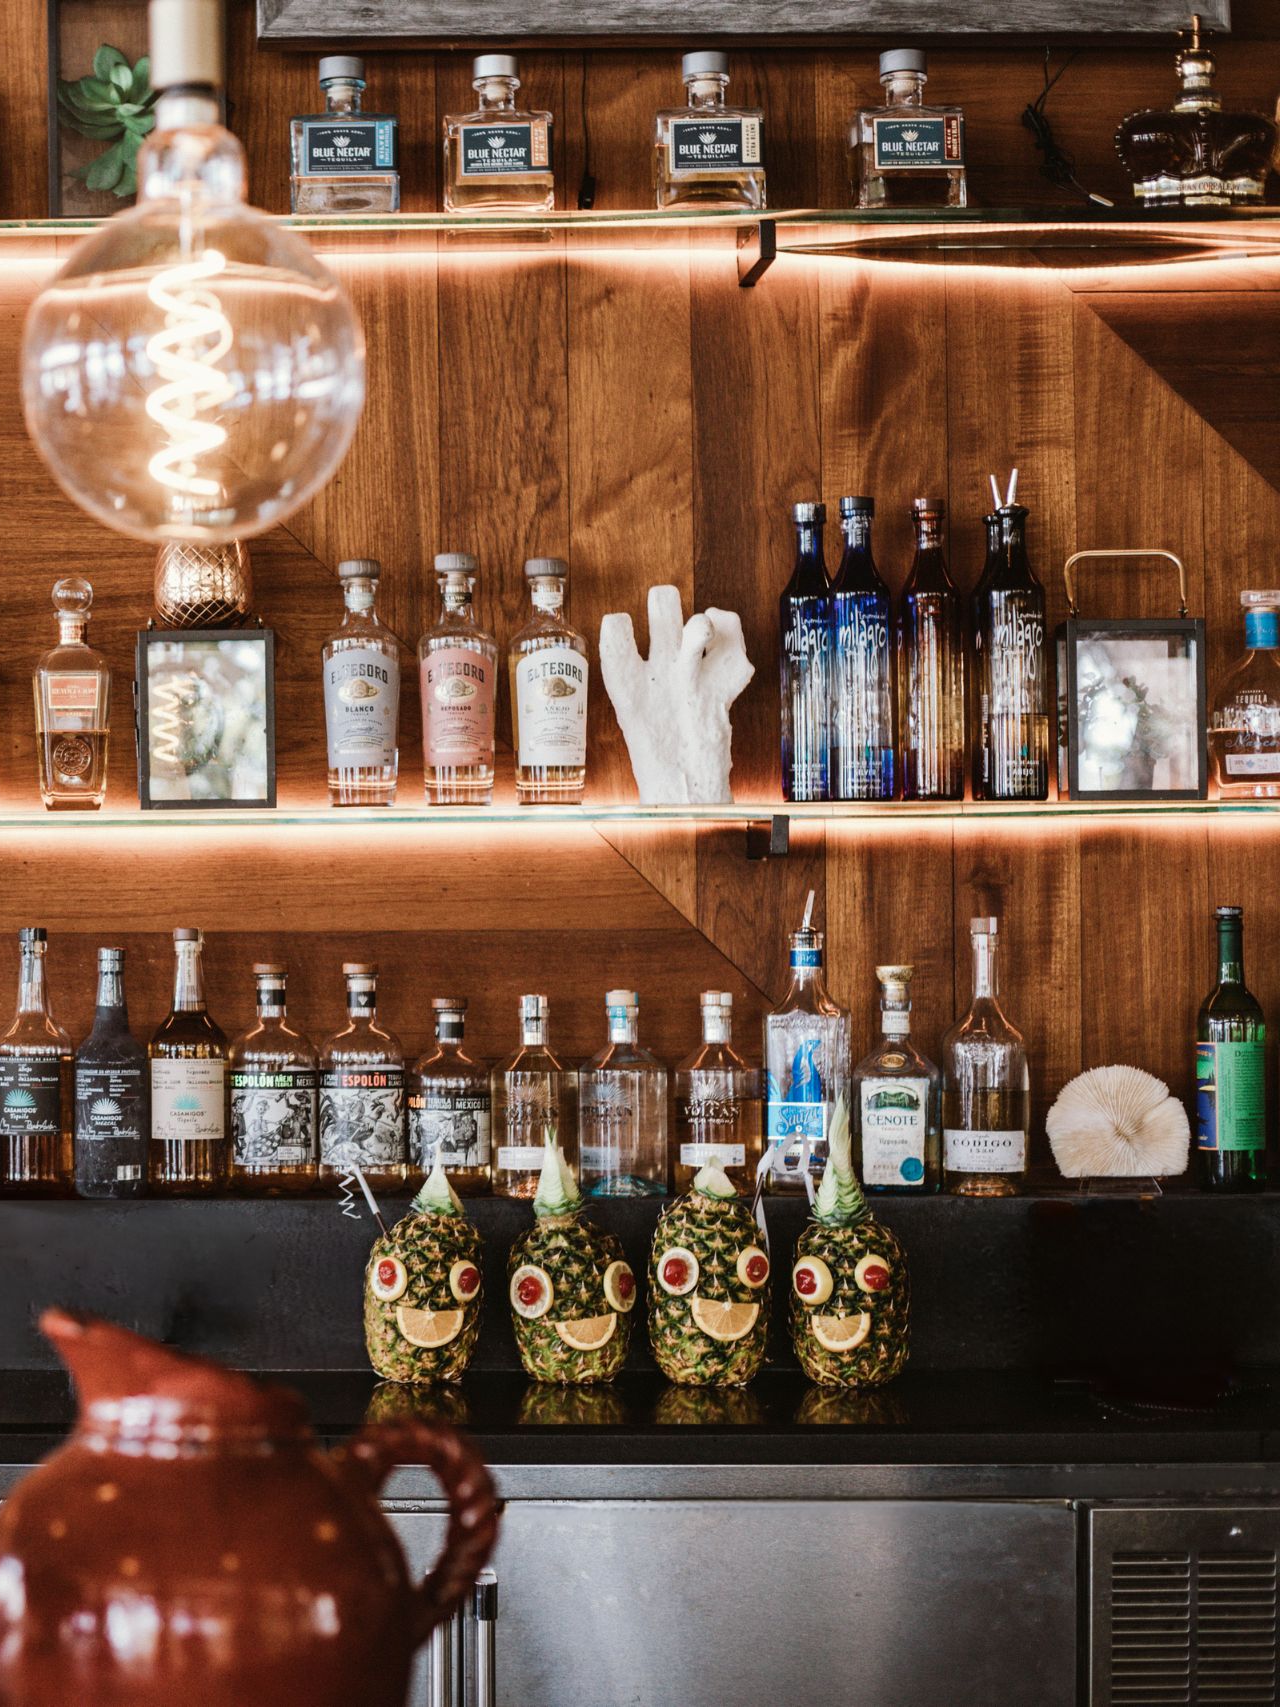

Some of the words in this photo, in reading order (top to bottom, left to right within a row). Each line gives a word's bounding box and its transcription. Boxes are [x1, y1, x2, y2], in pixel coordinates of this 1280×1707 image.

[679, 145, 701, 154] BLUE
[703, 144, 738, 154] NECTAR
[882, 142, 904, 152] BLUE
[906, 141, 940, 151] NECTAR
[312, 147, 335, 157] BLUE
[336, 147, 372, 157] NECTAR
[468, 149, 490, 159] BLUE
[492, 147, 526, 157] NECTAR
[527, 668, 540, 684] EL
[541, 662, 583, 683] TESORO
[1235, 694, 1268, 704] TEQUILA
[455, 1101, 481, 1109] MEXICO
[866, 1115, 918, 1126] CENOTE
[952, 1137, 1012, 1147] CÓDIGO
